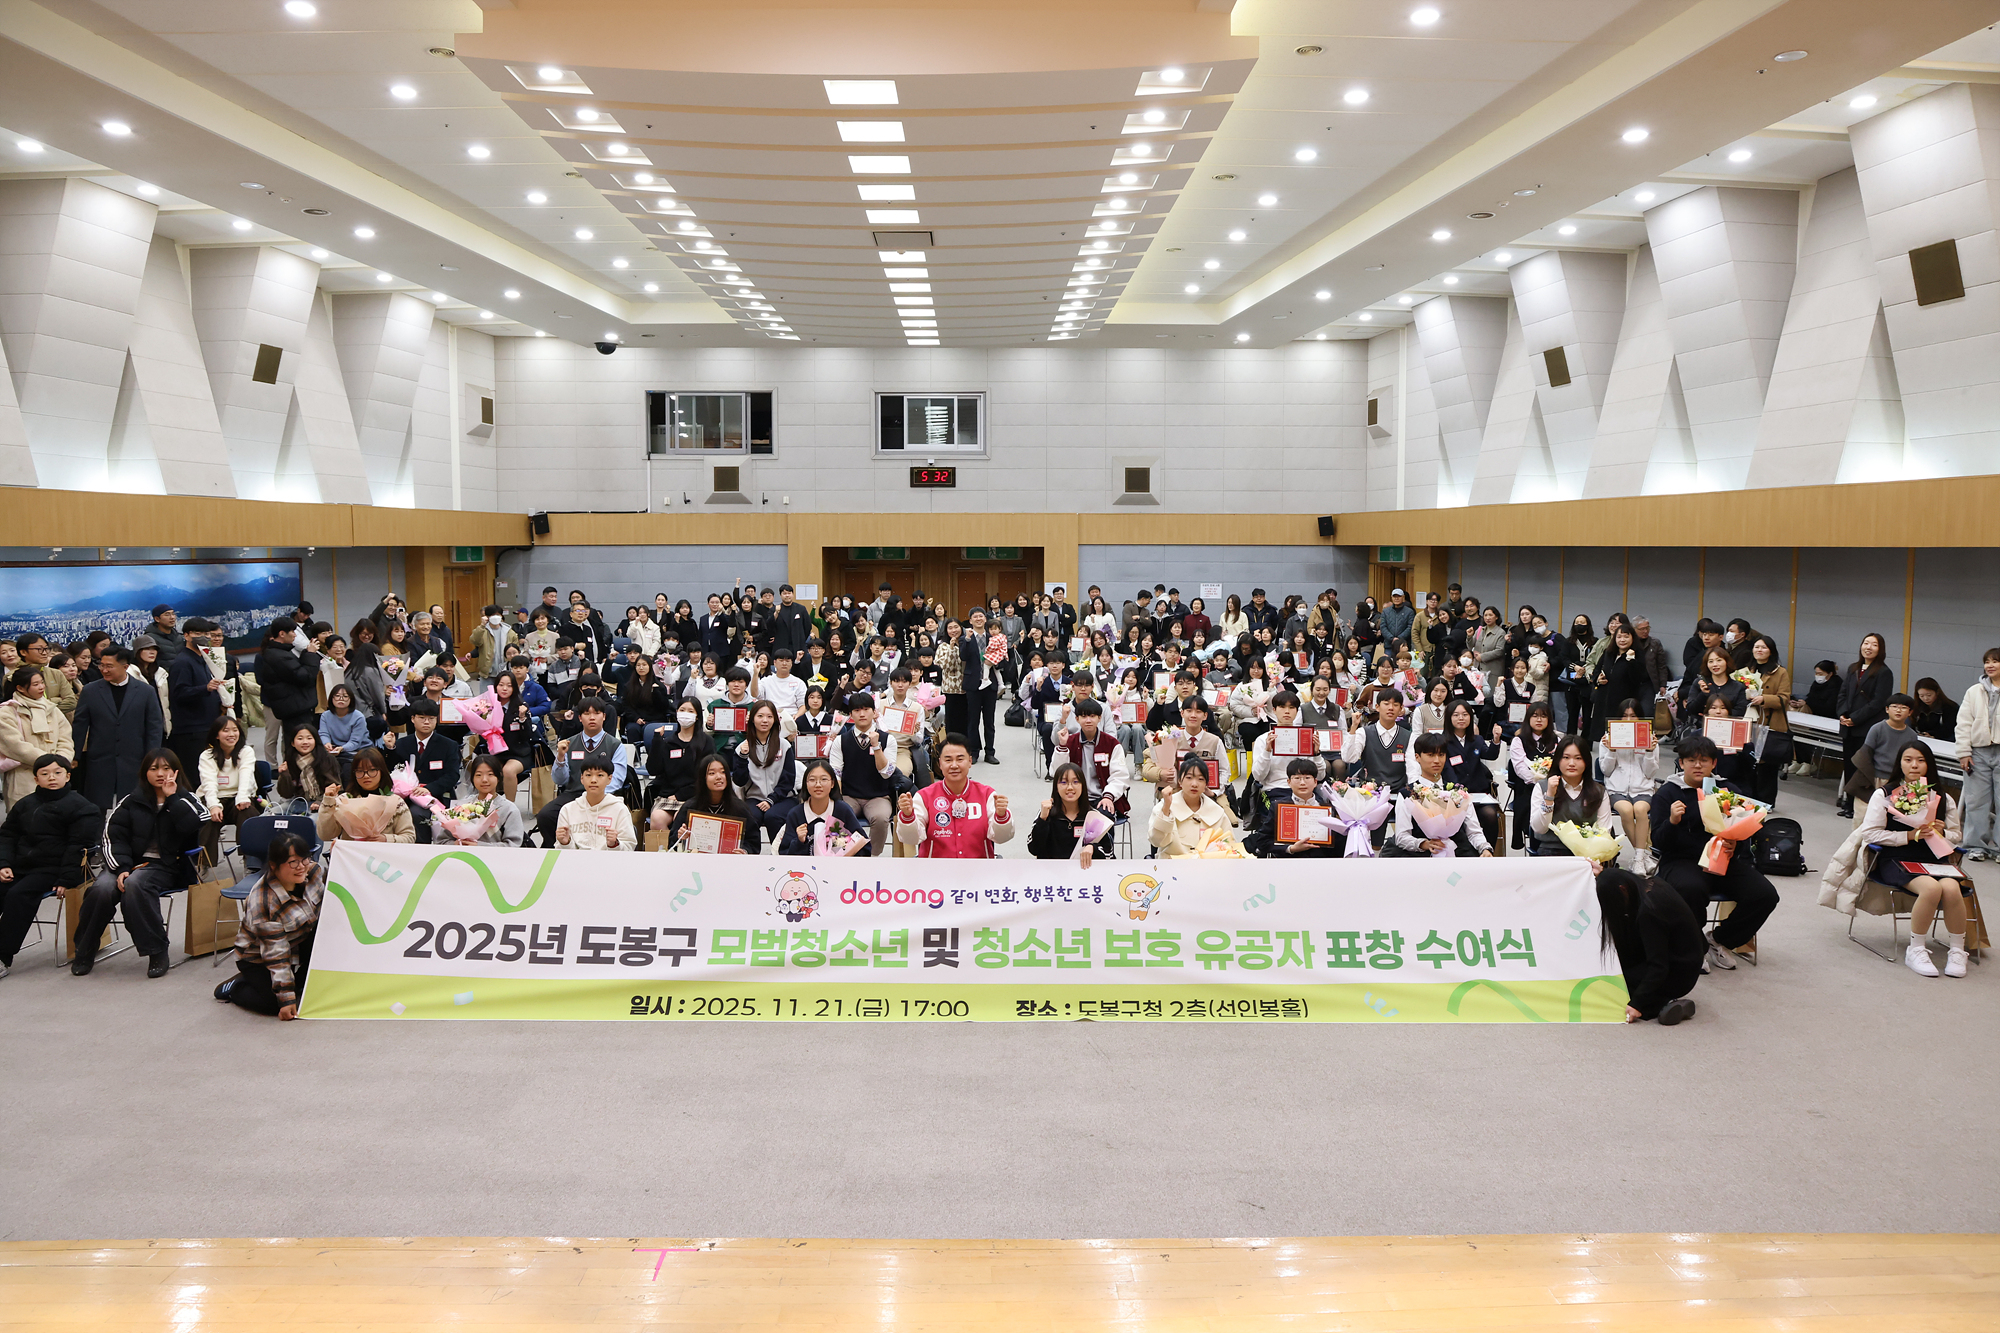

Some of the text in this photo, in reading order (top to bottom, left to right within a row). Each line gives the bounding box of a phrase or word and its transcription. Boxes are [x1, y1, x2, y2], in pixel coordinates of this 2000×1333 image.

[934, 471, 949, 482] 32
[967, 802, 983, 820] D
[840, 881, 944, 909] dobong
[950, 889, 978, 905] 같이
[1023, 885, 1073, 903] 행복한
[1077, 885, 1104, 904] 도봉
[403, 920, 1538, 971] 2025년 도봉구 모범청소년 및 청소년 보호 유공자 표창 수여식
[691, 997, 762, 1016] 2025.
[773, 998, 807, 1017] 11.
[814, 998, 890, 1018] 21.(금)
[900, 1000, 970, 1017] 17:00
[1078, 999, 1163, 1018] 도봉구청
[1169, 998, 1309, 1019] 2층(선인봉홀)
